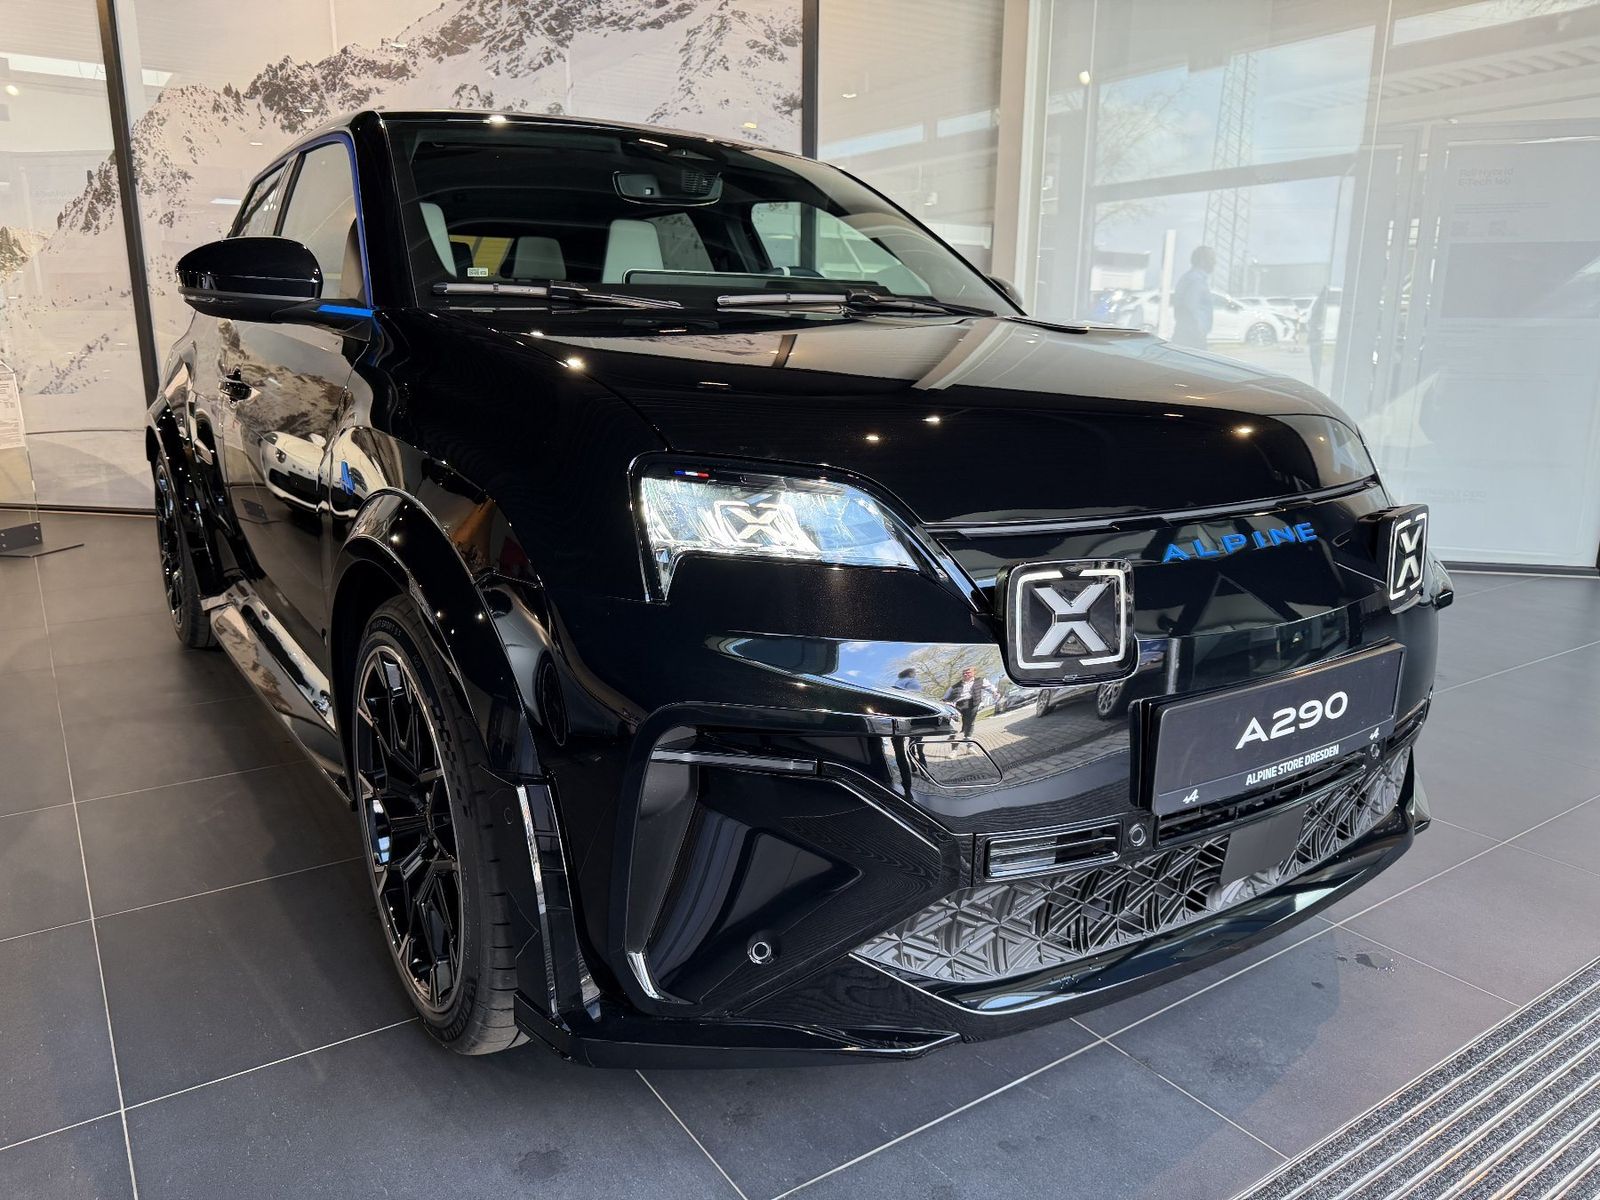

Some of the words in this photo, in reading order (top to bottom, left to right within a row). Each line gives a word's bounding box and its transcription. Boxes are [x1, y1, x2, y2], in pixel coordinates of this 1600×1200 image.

[1161, 521, 1318, 564] ALPINE
[1235, 691, 1348, 750] A290
[1245, 766, 1278, 786] ALPINE
[1277, 757, 1304, 775] STORE
[1304, 743, 1340, 766] DRESDEN
